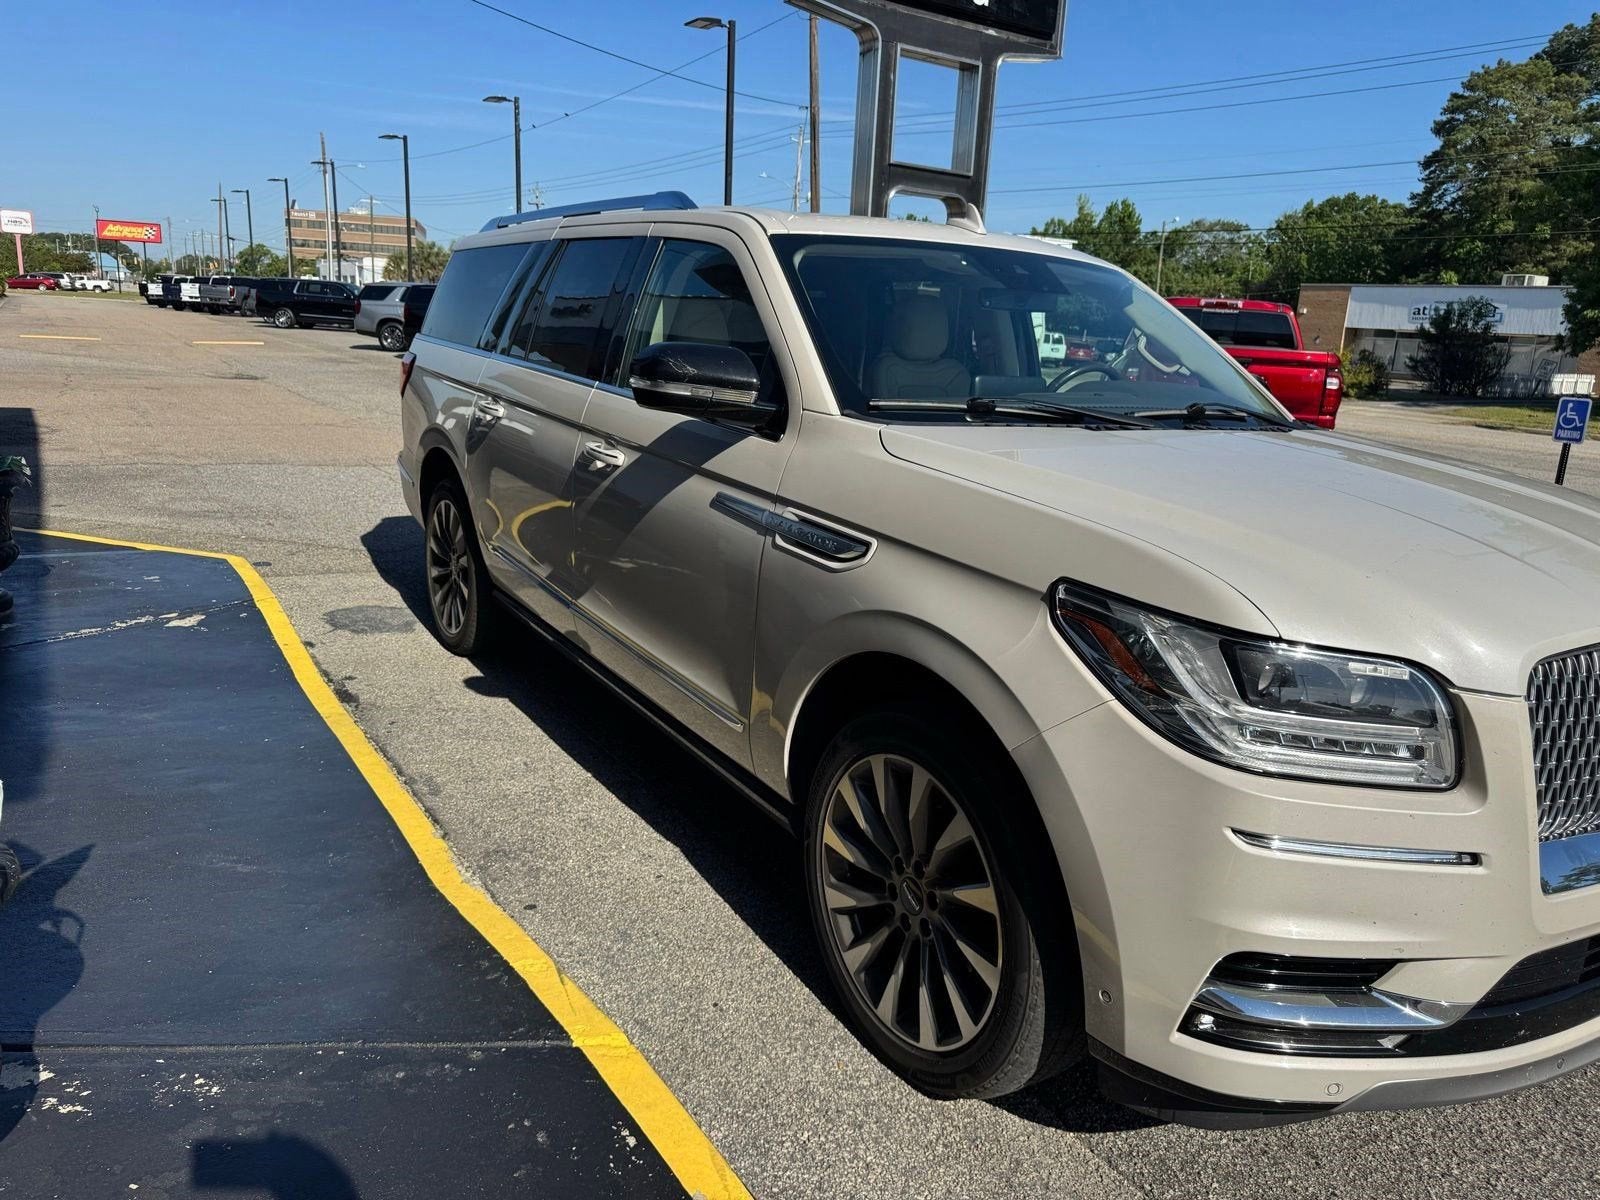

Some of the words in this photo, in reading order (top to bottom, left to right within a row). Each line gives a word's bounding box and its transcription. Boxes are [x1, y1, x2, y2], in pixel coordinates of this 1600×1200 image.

[106, 223, 144, 233] Advance
[121, 231, 144, 239] Parts
[1556, 429, 1581, 439] PARKING
